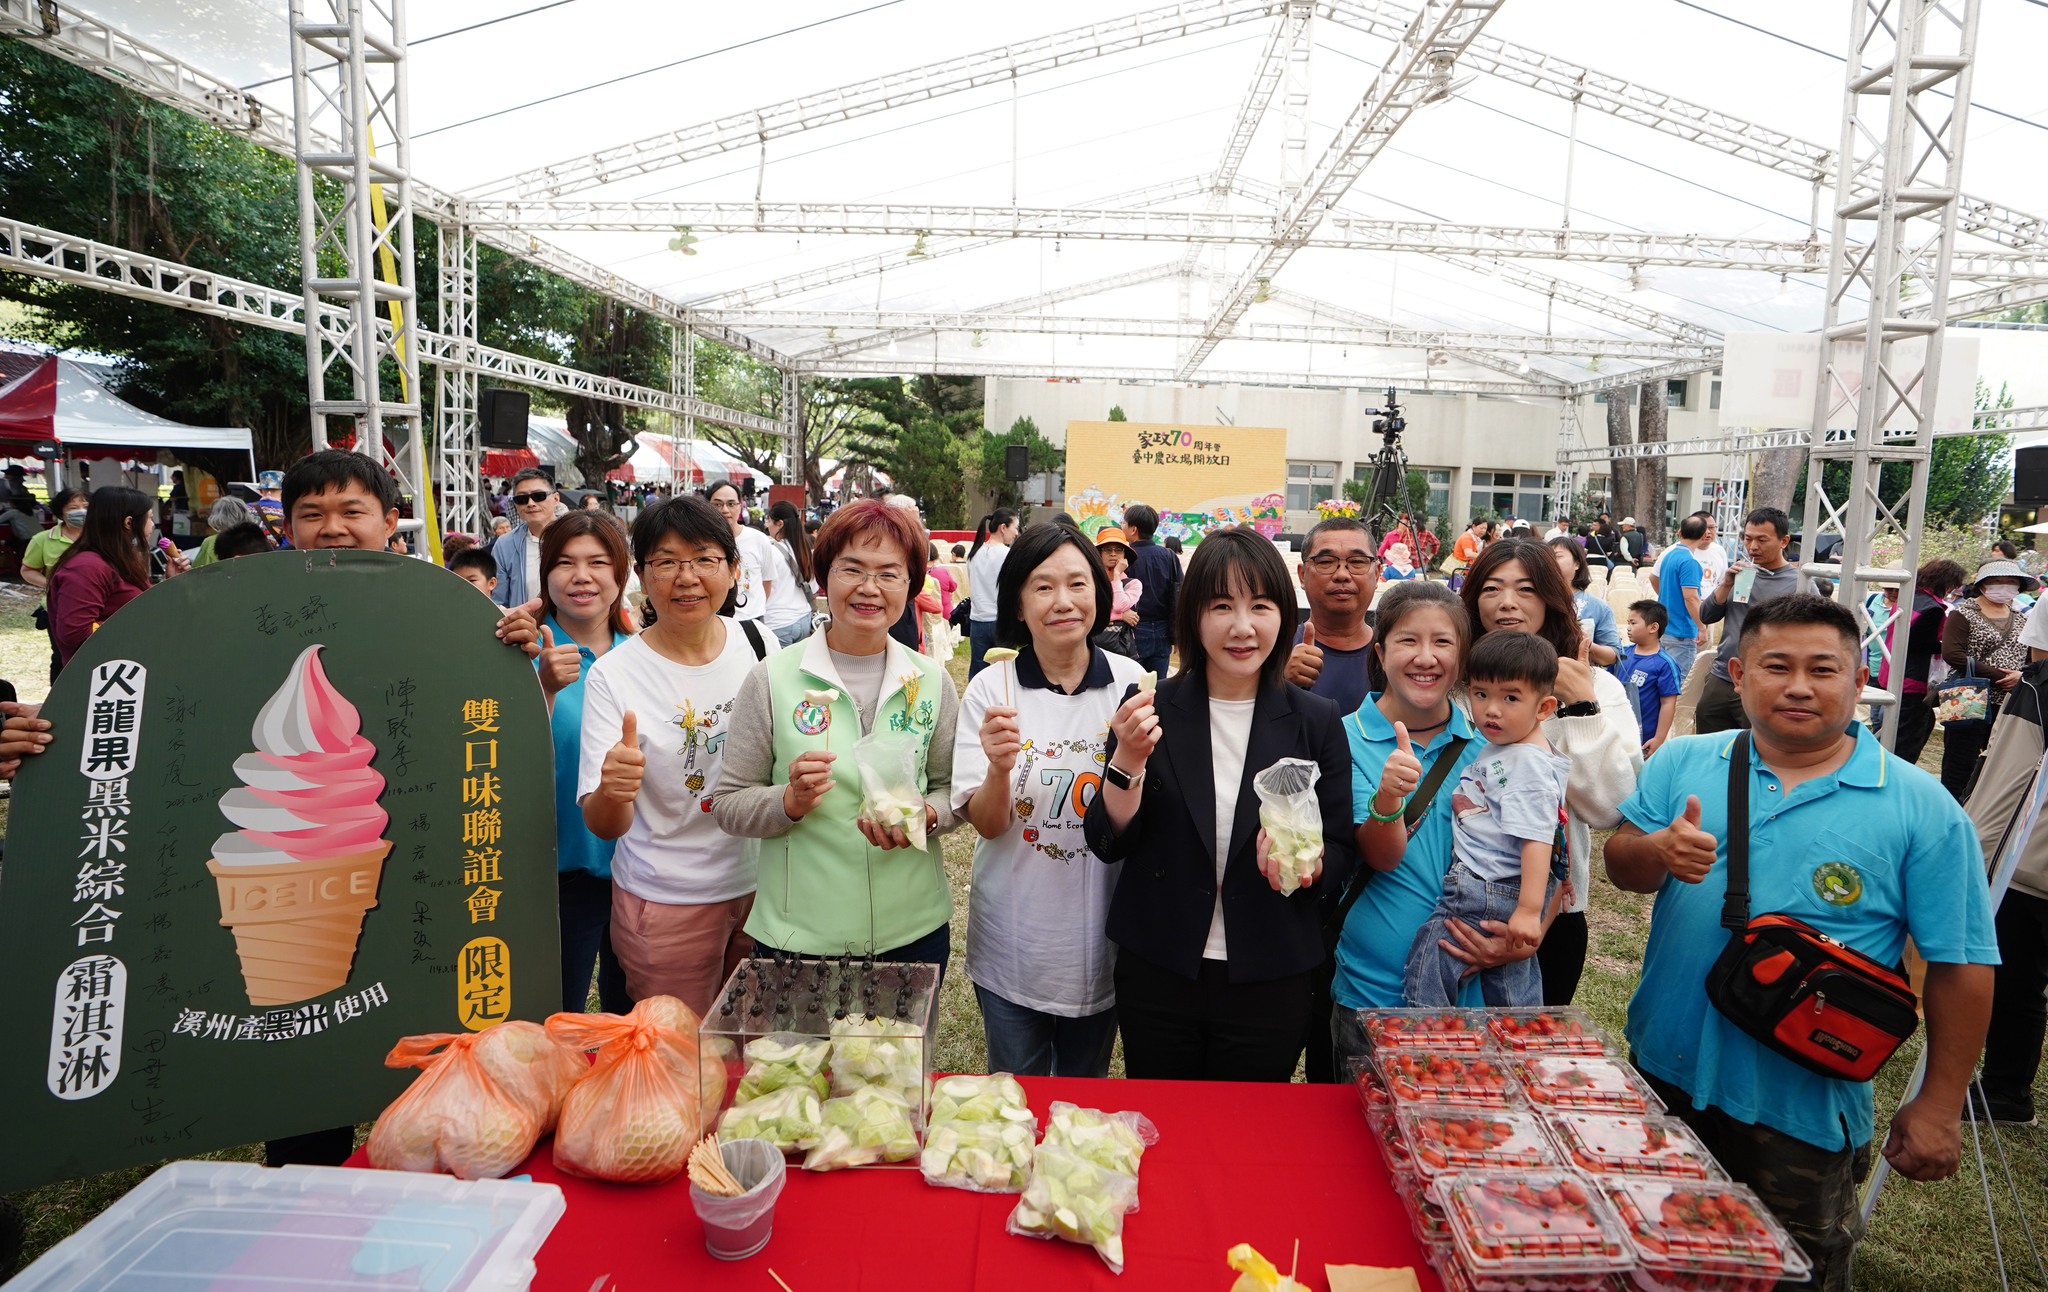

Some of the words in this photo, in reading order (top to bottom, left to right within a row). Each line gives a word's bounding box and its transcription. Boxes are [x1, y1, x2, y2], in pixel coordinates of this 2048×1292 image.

[1132, 448, 1230, 466] 臺中農改場開放日
[87, 662, 141, 773] 火龍果
[462, 698, 503, 924] 雙口味聯誼會
[1040, 768, 1102, 819] 70
[1042, 820, 1062, 829] Home
[71, 777, 132, 947] 黑米綜合
[229, 882, 297, 911] ICE
[308, 871, 374, 903] ICE
[58, 955, 114, 1093] 霜淇淋
[464, 943, 506, 1025] 限定
